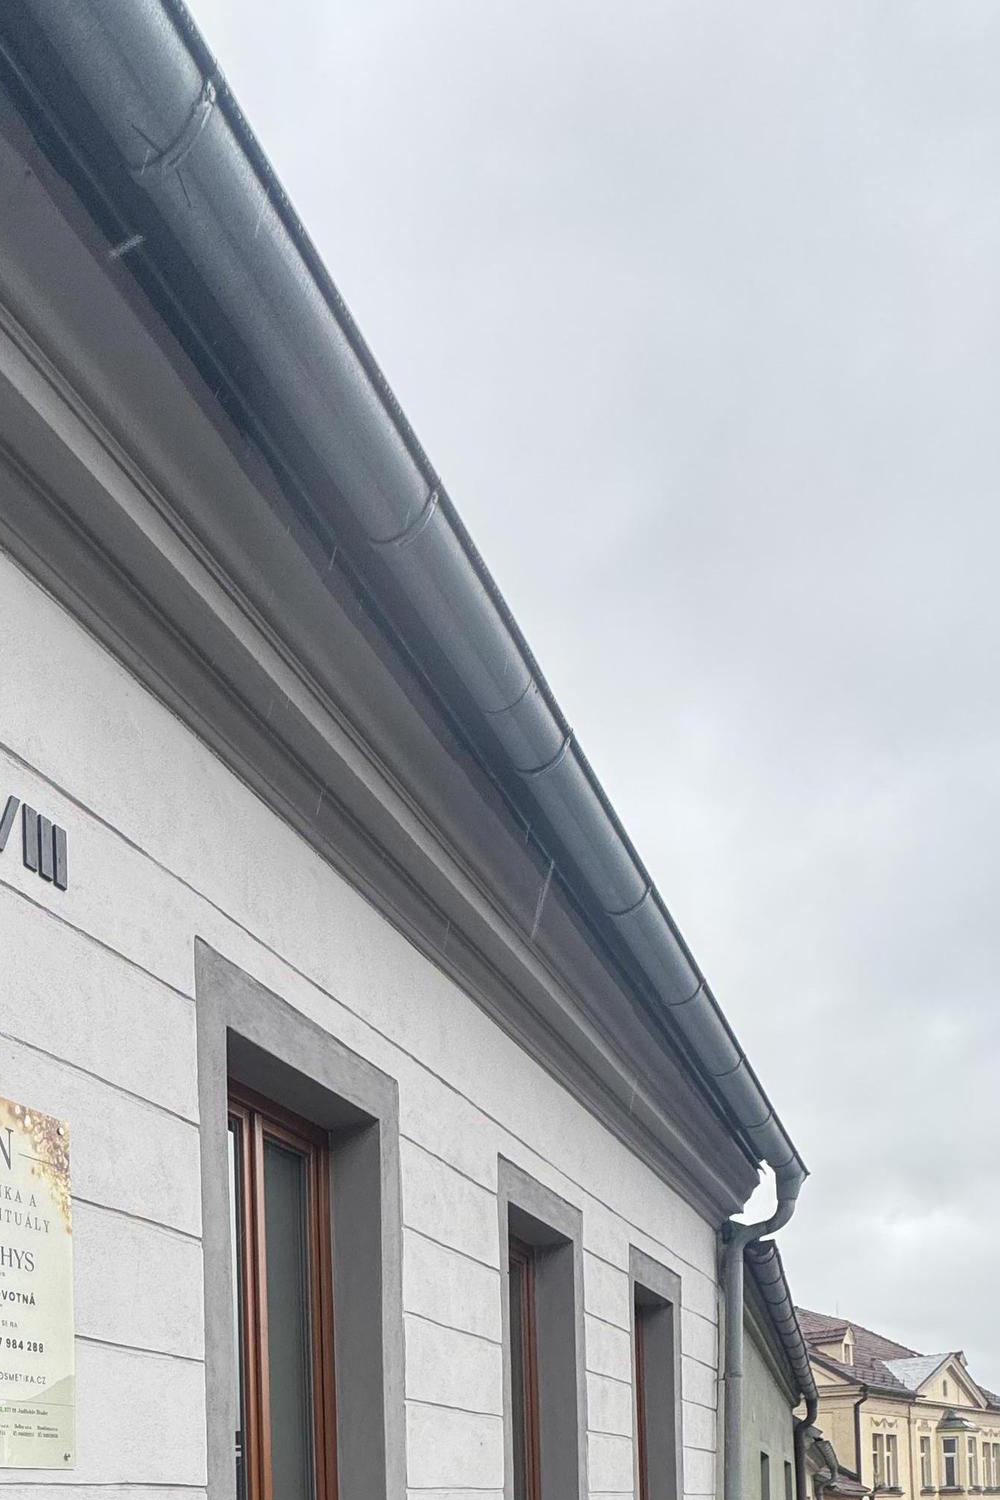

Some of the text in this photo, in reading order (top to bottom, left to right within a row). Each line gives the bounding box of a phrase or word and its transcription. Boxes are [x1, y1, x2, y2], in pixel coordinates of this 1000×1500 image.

[29, 1194, 37, 1208] A
[5, 1338, 24, 1351] 984
[26, 1341, 45, 1354] 288
